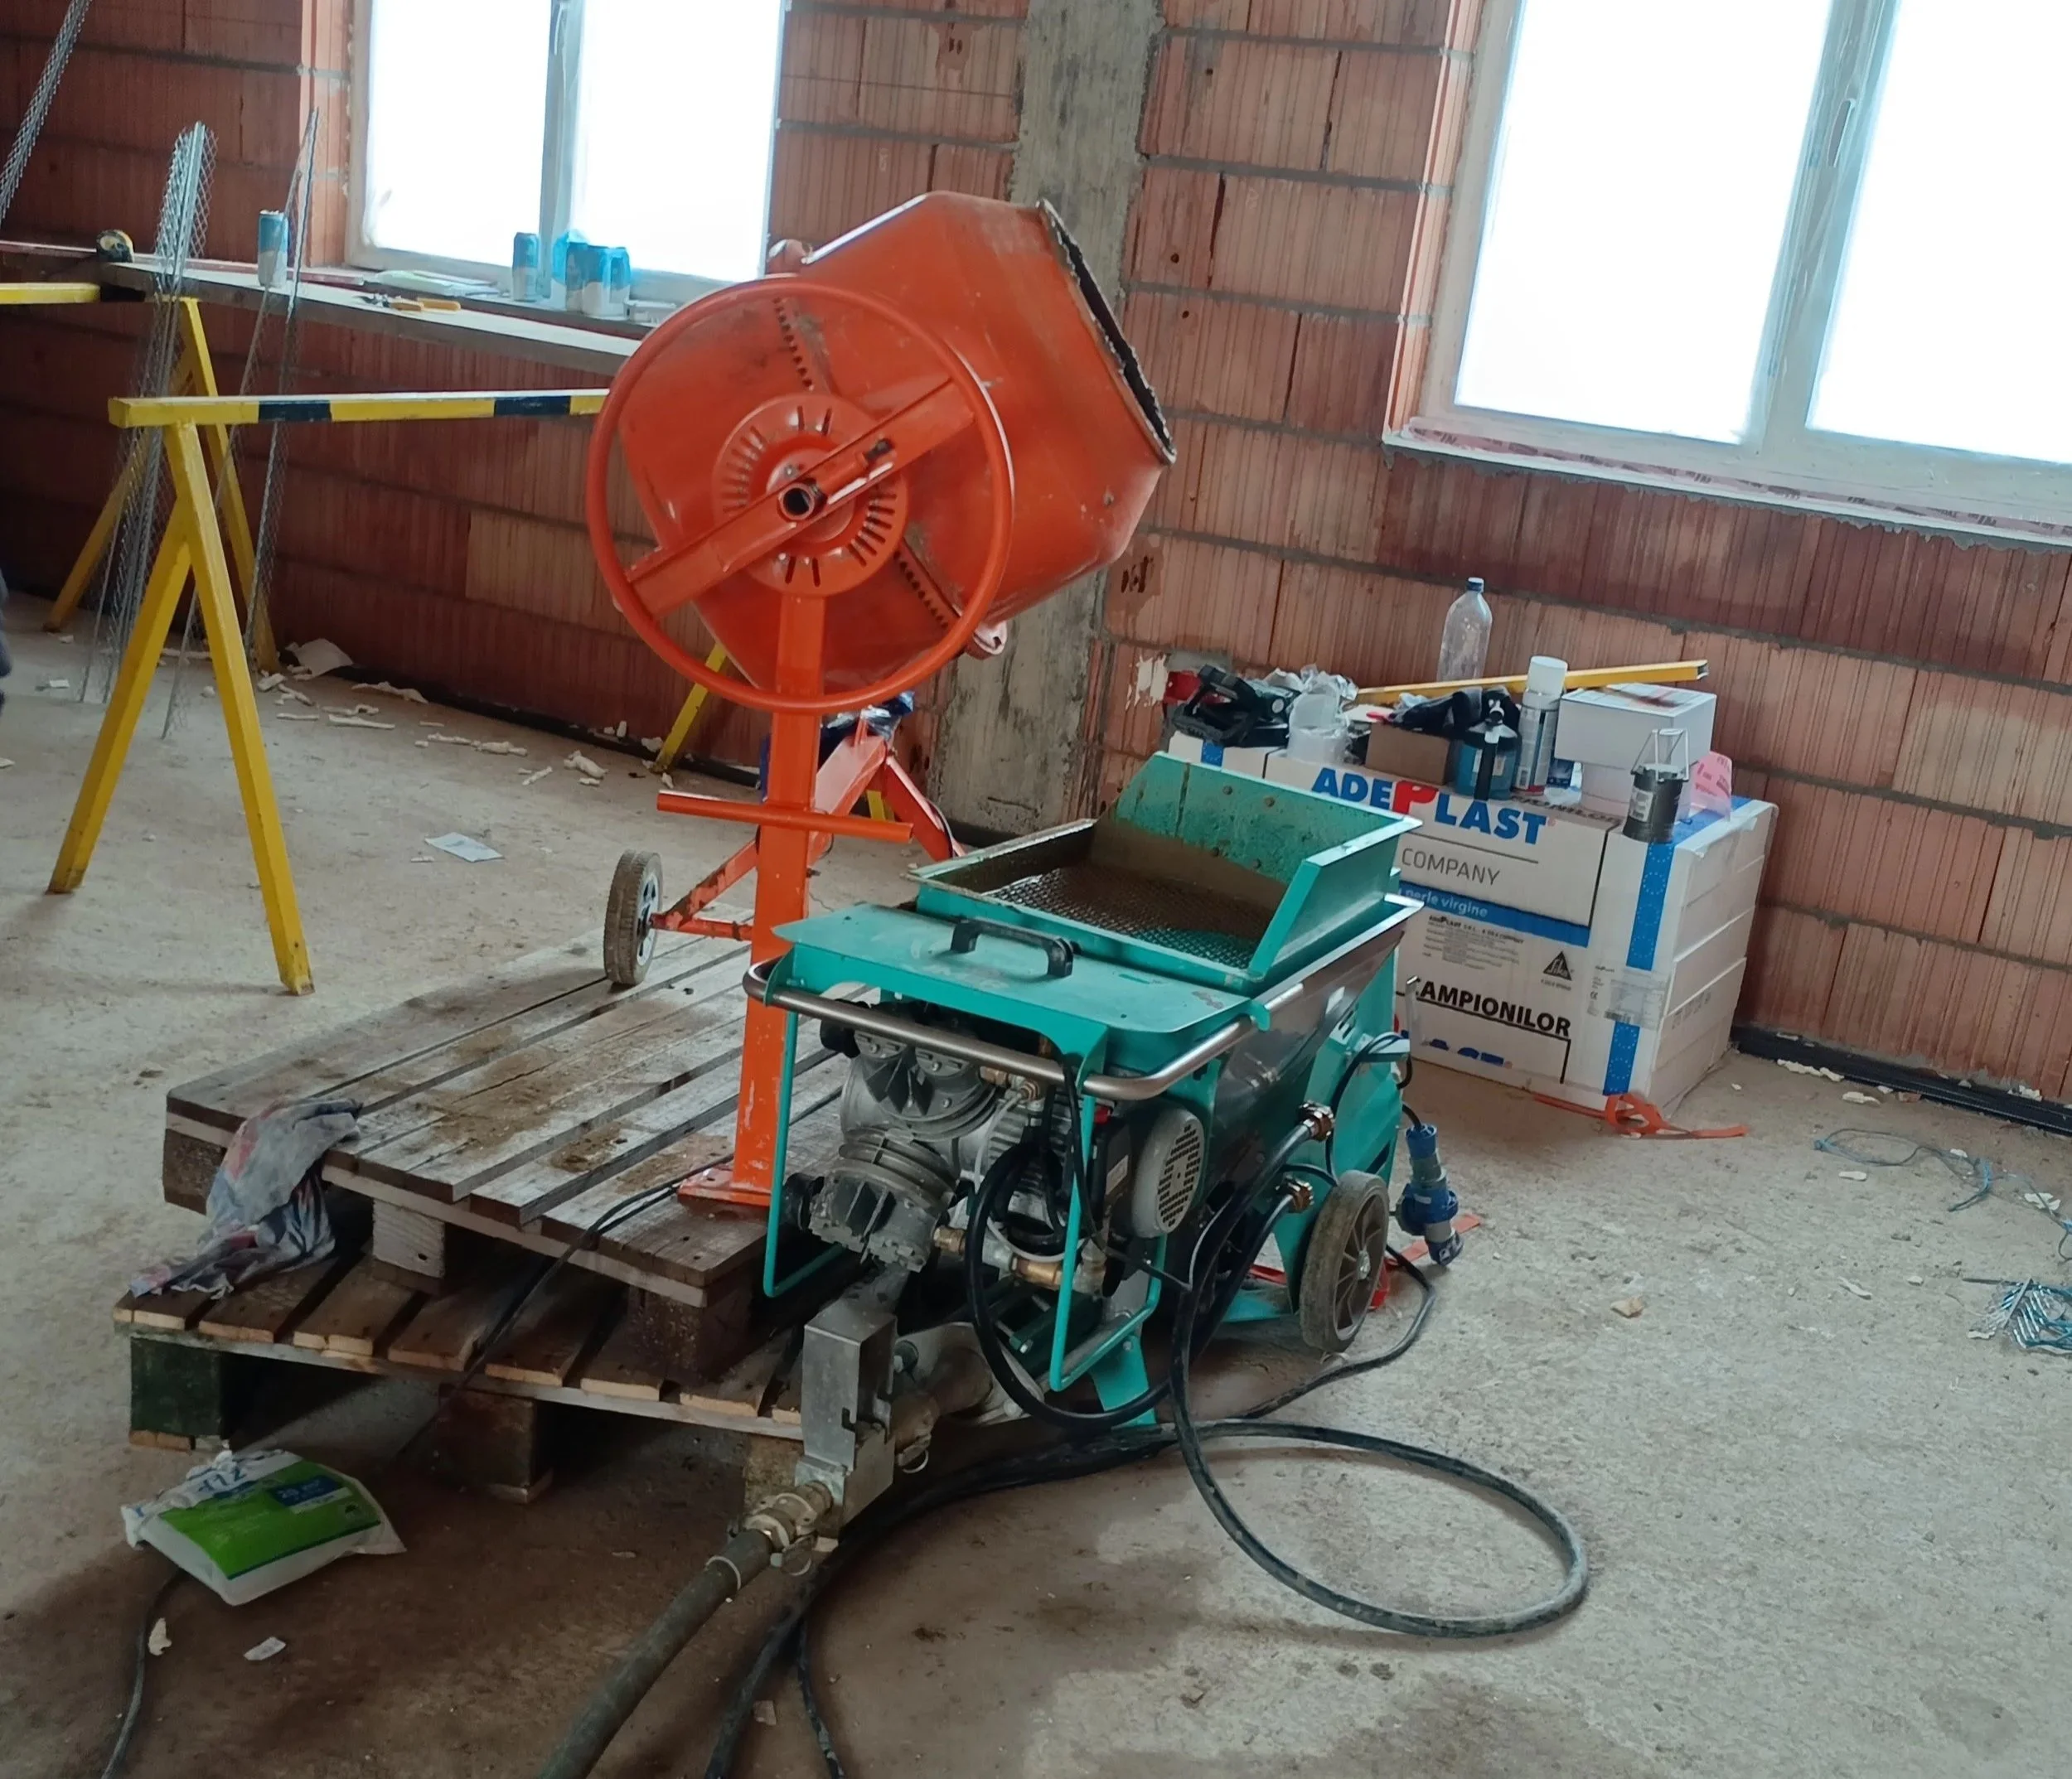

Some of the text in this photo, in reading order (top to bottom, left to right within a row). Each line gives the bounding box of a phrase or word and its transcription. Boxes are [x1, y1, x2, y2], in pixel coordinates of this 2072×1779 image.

[1311, 767, 1547, 845] ADEPLAST
[1402, 848, 1501, 886] COMPANY
[1440, 896, 1489, 918] virgine
[1415, 978, 1571, 1037] AMPIONILOR
